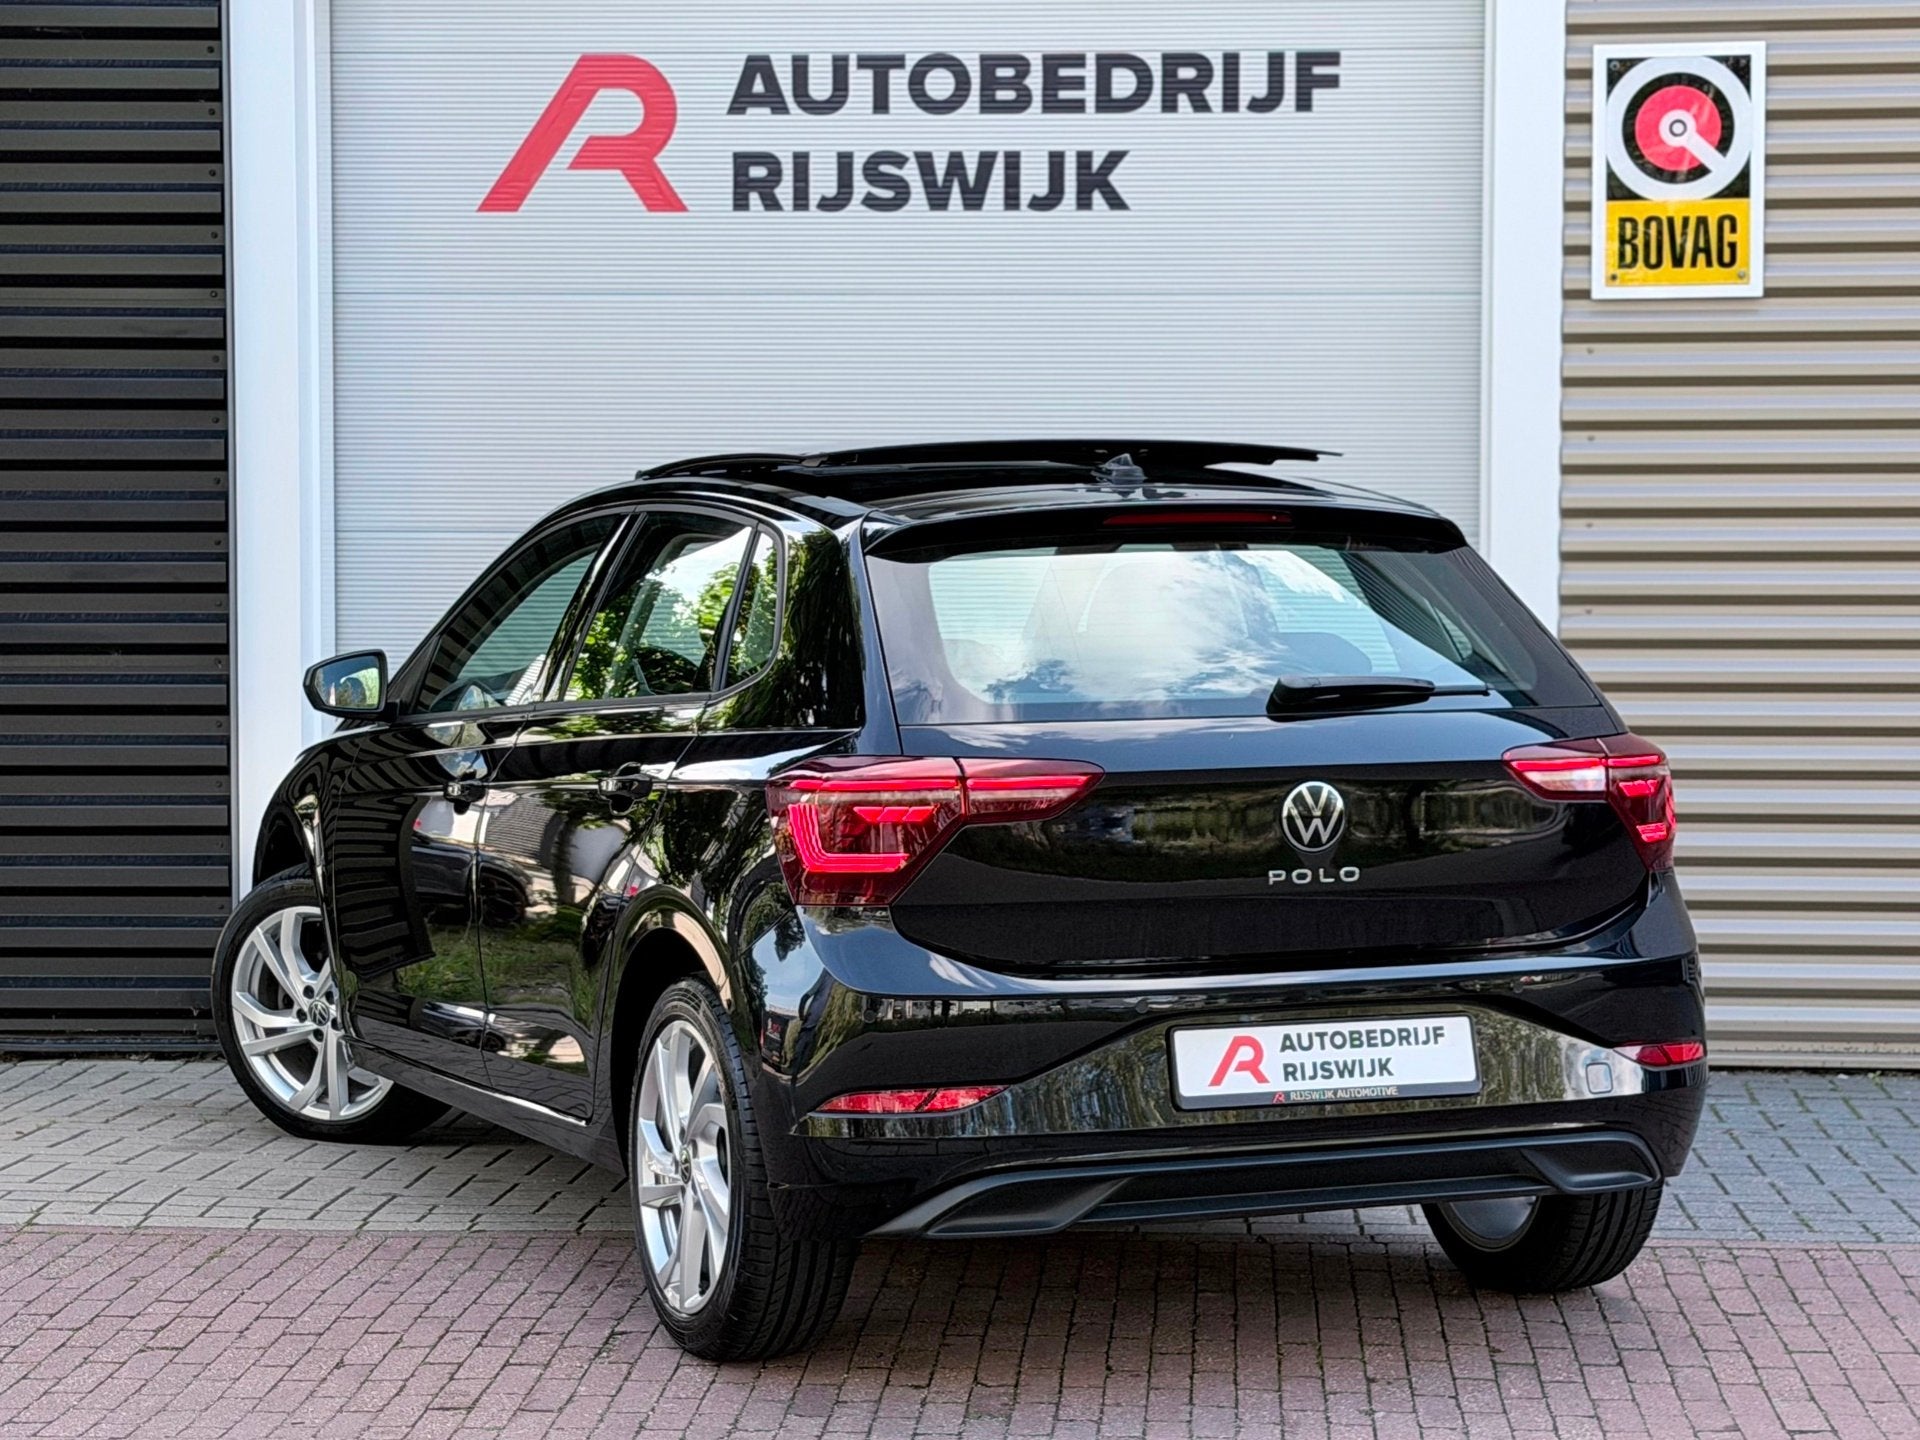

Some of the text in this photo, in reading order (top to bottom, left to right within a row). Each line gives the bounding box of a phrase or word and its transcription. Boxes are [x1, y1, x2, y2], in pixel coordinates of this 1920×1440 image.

[727, 51, 1341, 116] AUTOBEDRIJF
[732, 150, 1130, 211] RIJSWIJK
[1618, 215, 1737, 269] BOVAG
[1268, 866, 1361, 885] POLO
[1280, 1026, 1445, 1053] AUTOBEDRIJF
[1282, 1057, 1394, 1082] RIJSWIJK
[1290, 1089, 1335, 1101] RIJSWIJK
[1336, 1086, 1398, 1099] AUTOMOTIVE
